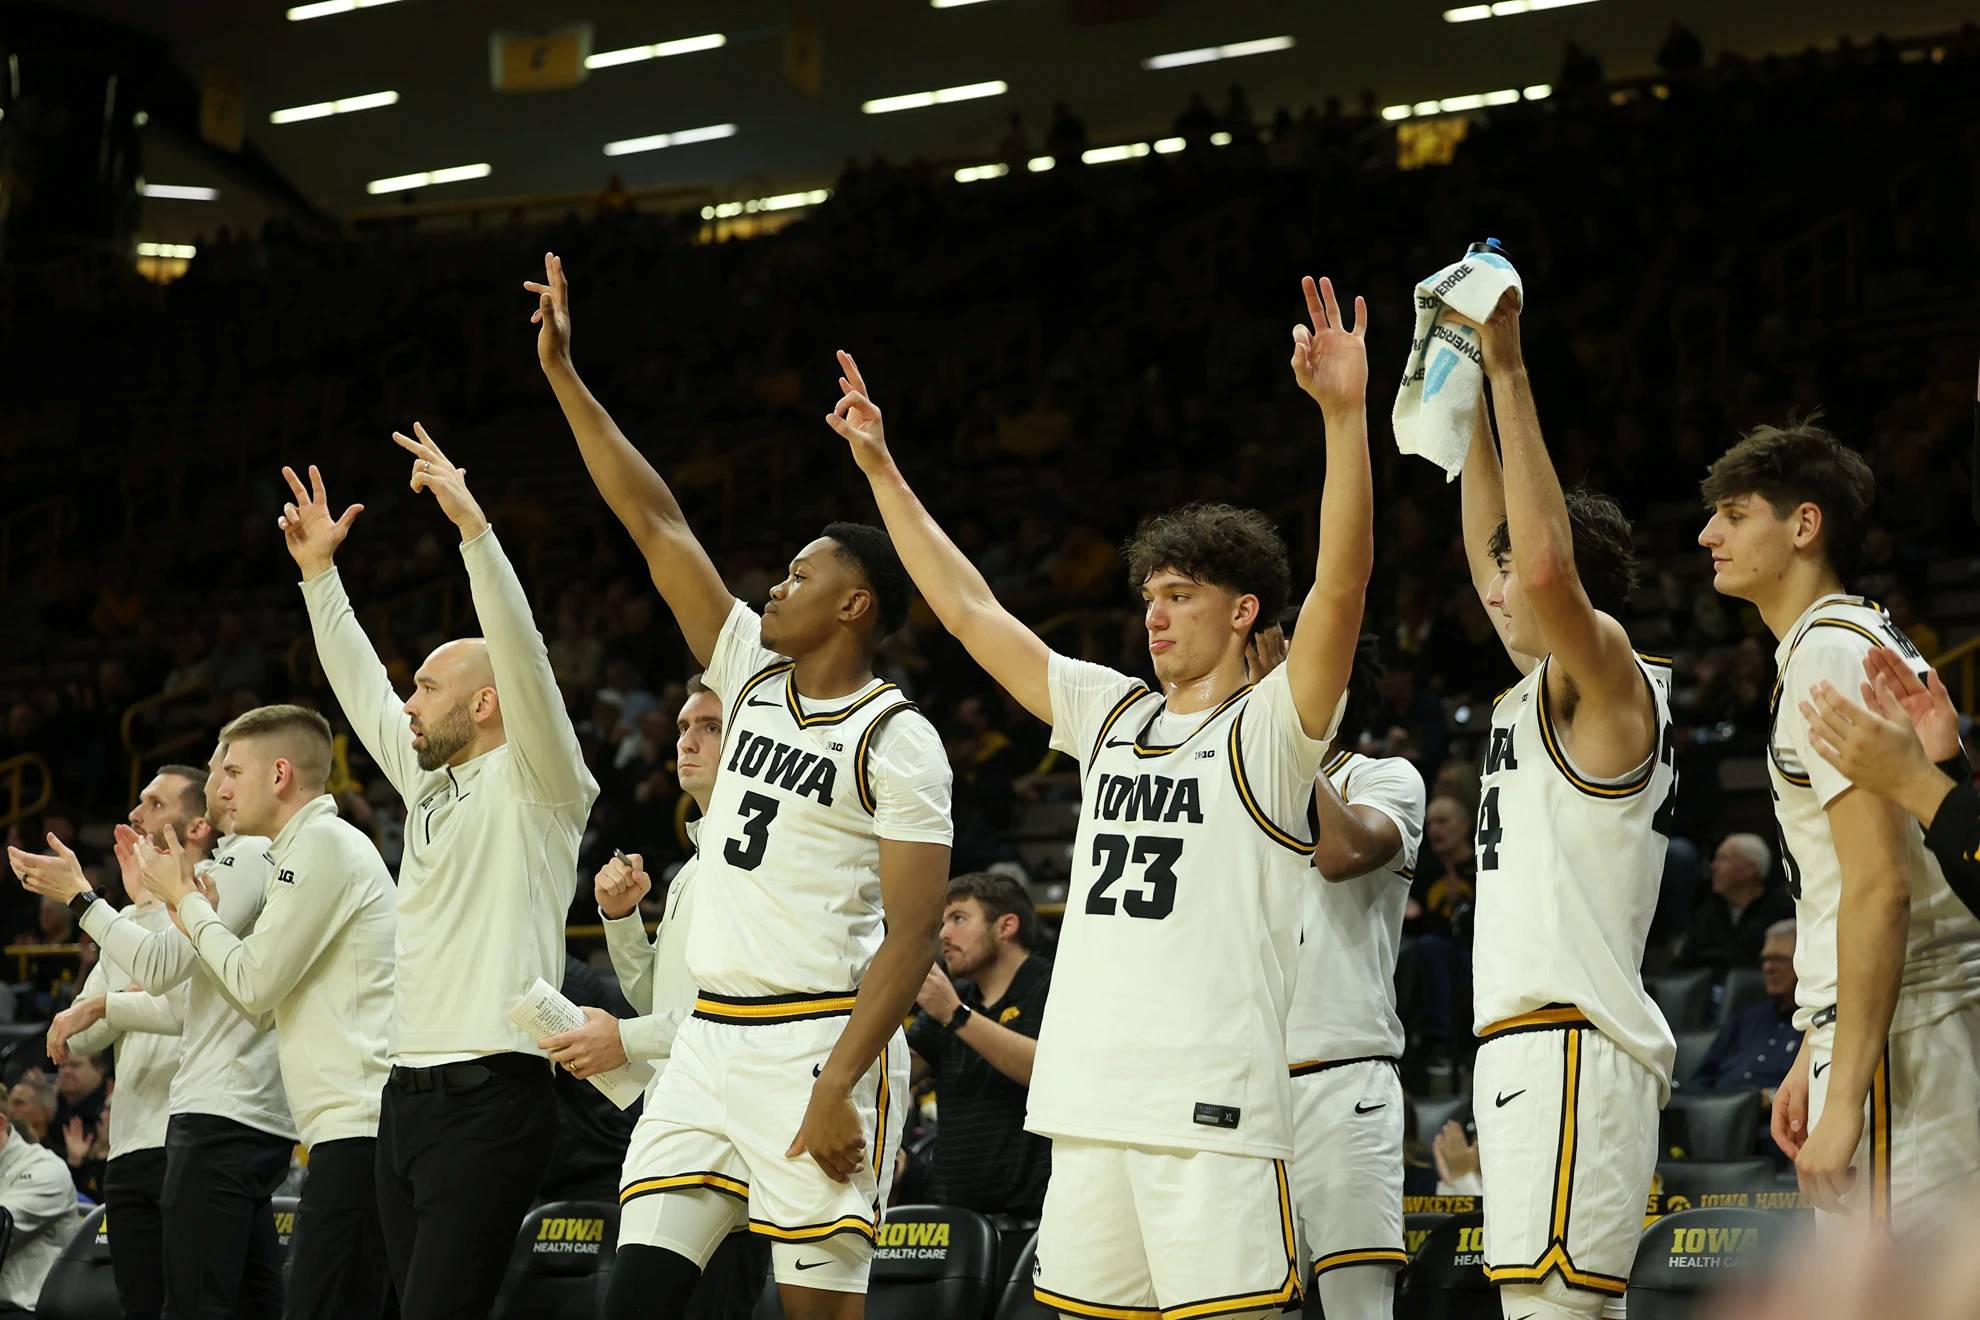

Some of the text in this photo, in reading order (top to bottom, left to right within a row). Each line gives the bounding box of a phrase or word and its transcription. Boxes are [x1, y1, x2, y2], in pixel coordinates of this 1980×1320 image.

[1483, 724, 1517, 775] WA
[727, 730, 837, 807] IOWA
[1094, 774, 1203, 824] IOWA
[723, 790, 780, 872] 3
[1477, 787, 1503, 872] 4
[1085, 833, 1184, 920] 23
[1701, 1194, 1748, 1208] IOWA
[537, 1218, 604, 1241] IOWA
[877, 1223, 949, 1246] IOWA
[1671, 1228, 1759, 1253] IOWA
[533, 1242, 600, 1254] HEALTH CARE
[874, 1249, 947, 1260] HEALTH CARE
[1454, 1255, 1485, 1266] HEA
[1669, 1257, 1720, 1268] HEALTH
